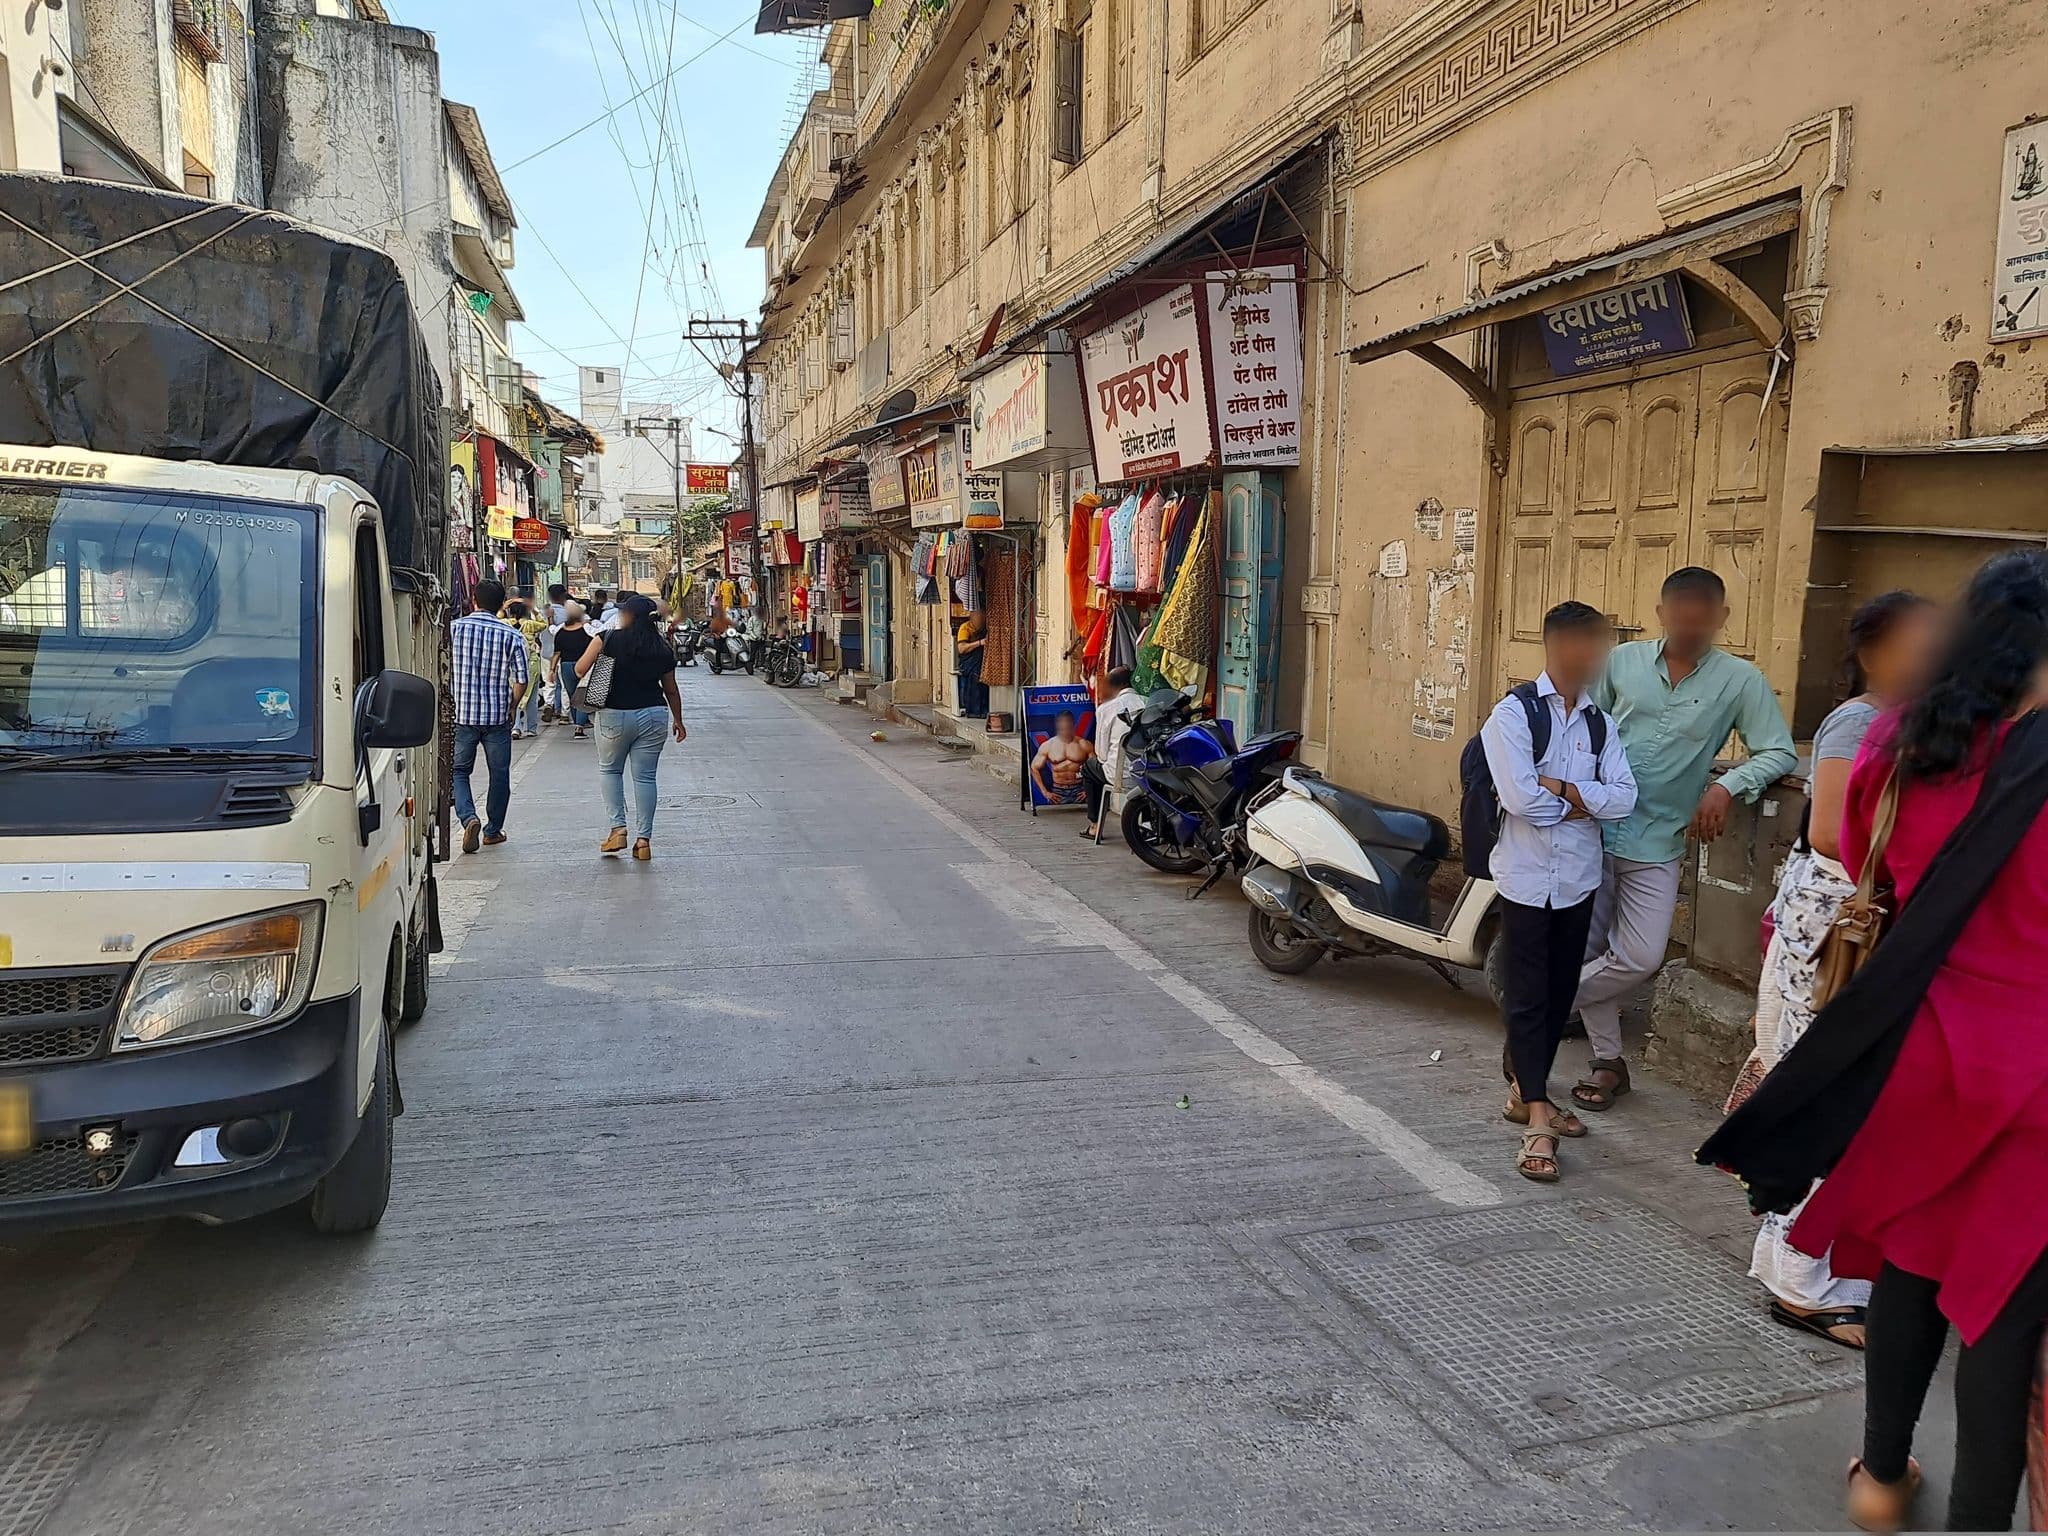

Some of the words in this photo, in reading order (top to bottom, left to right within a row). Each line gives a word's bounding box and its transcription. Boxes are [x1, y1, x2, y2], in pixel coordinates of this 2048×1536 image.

[1544, 277, 1669, 338] दवाखाना
[1230, 333, 1249, 356] शर्ट
[1252, 333, 1275, 353] पीस
[1253, 362, 1277, 382] पीस
[1097, 348, 1189, 432] प्रकाश
[1227, 392, 1259, 415] टॉवेल
[1262, 389, 1288, 410] टोपी
[1267, 418, 1296, 438] वेअर
[1118, 428, 1146, 458] रेडीमेड
[1224, 451, 1250, 464] होलसेल
[1253, 449, 1275, 458] भावात
[689, 466, 726, 480] सुयोग
[175, 511, 188, 522] M
[1062, 693, 1090, 702] VENU
